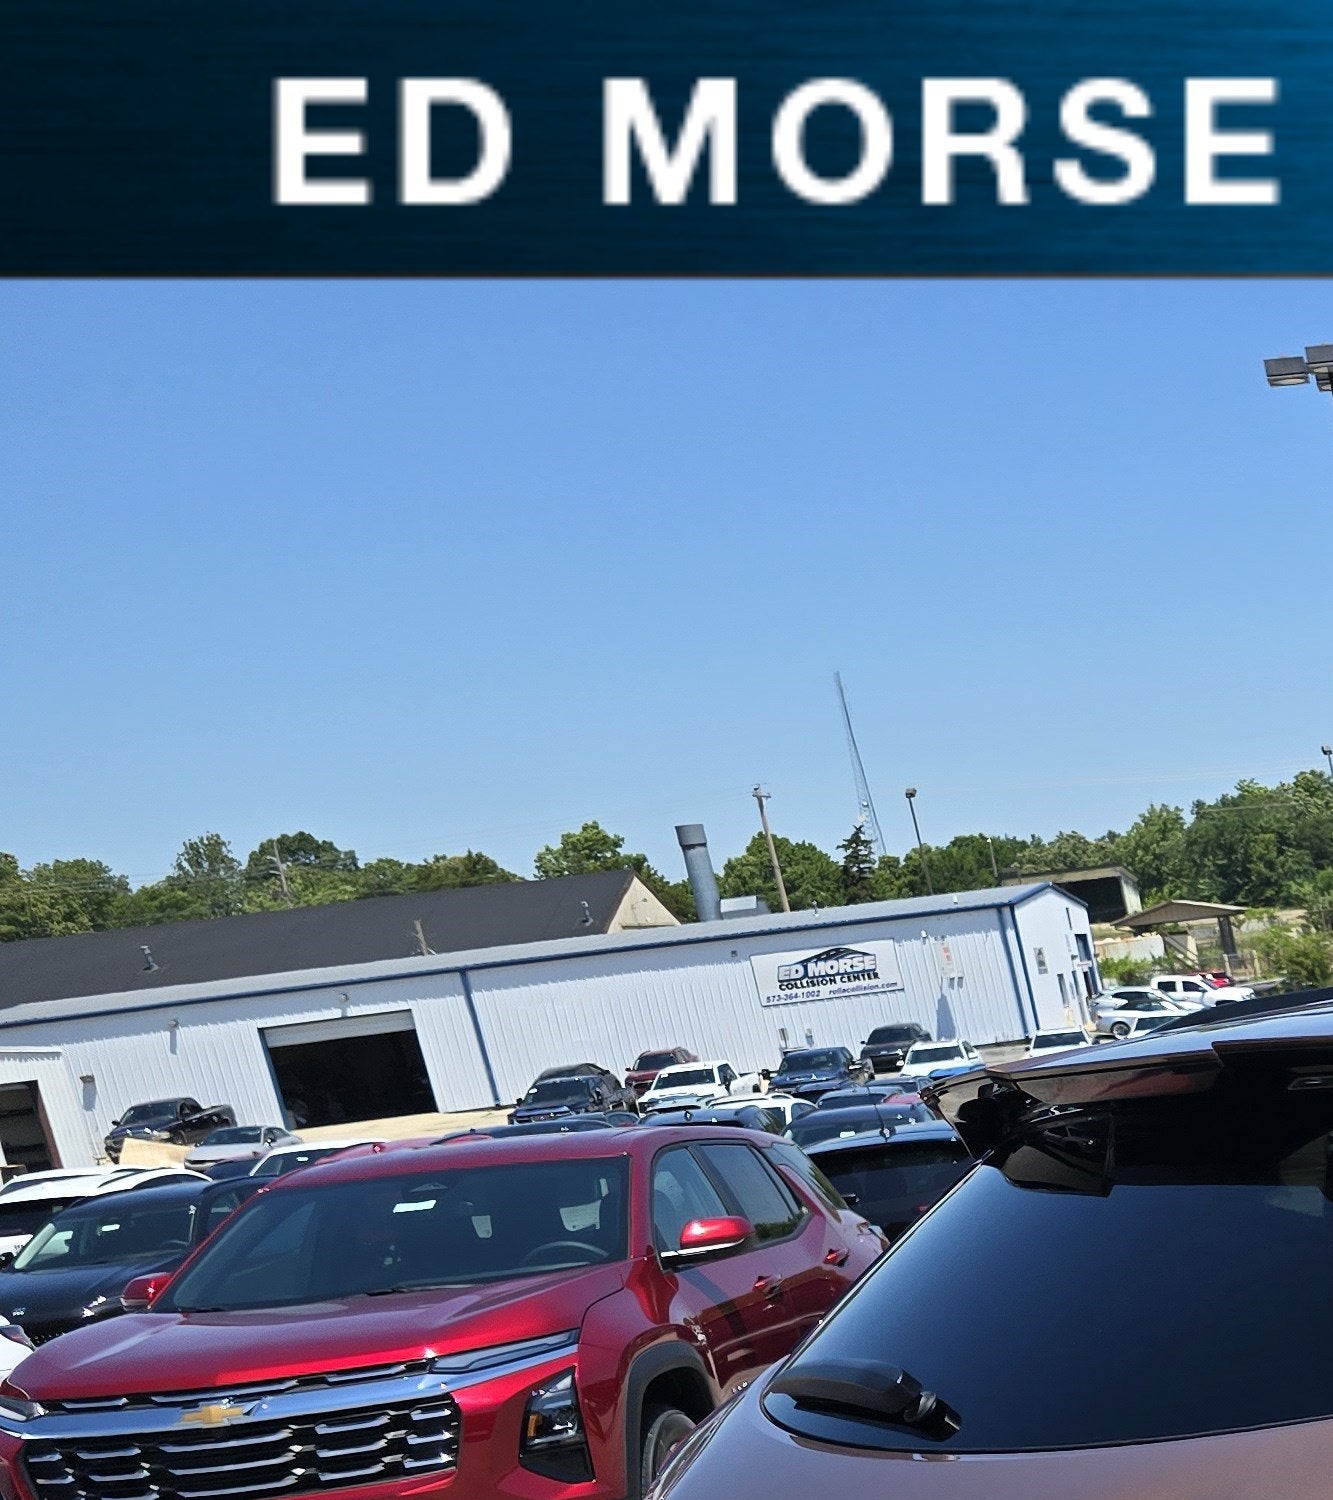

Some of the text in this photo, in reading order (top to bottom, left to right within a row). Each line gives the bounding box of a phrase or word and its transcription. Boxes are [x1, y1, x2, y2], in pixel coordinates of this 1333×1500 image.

[778, 954, 877, 980] ED MORSE
[766, 981, 898, 1004] 573-364-1002 rollacollision.com
[778, 971, 881, 991] COLLISION CENTER
